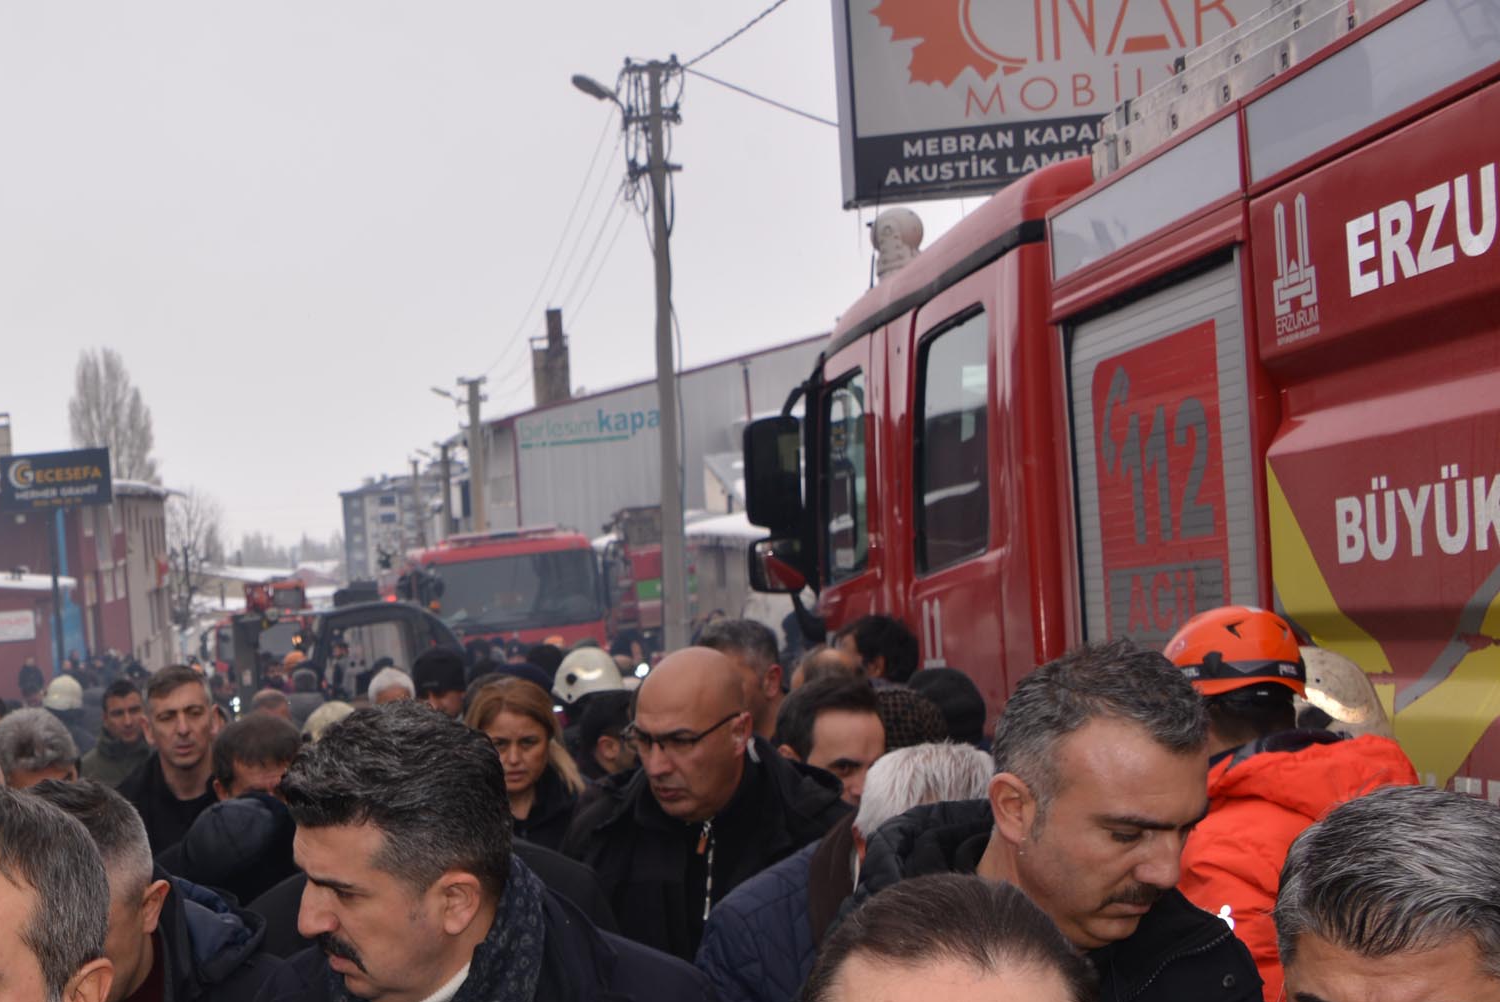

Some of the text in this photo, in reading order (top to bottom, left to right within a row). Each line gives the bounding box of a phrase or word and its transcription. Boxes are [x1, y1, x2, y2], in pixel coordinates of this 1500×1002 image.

[884, 154, 997, 186] AKUSTİK
[902, 129, 1014, 158] MEBRAN
[1345, 162, 1498, 298] ERZU
[1120, 396, 1215, 545] 112
